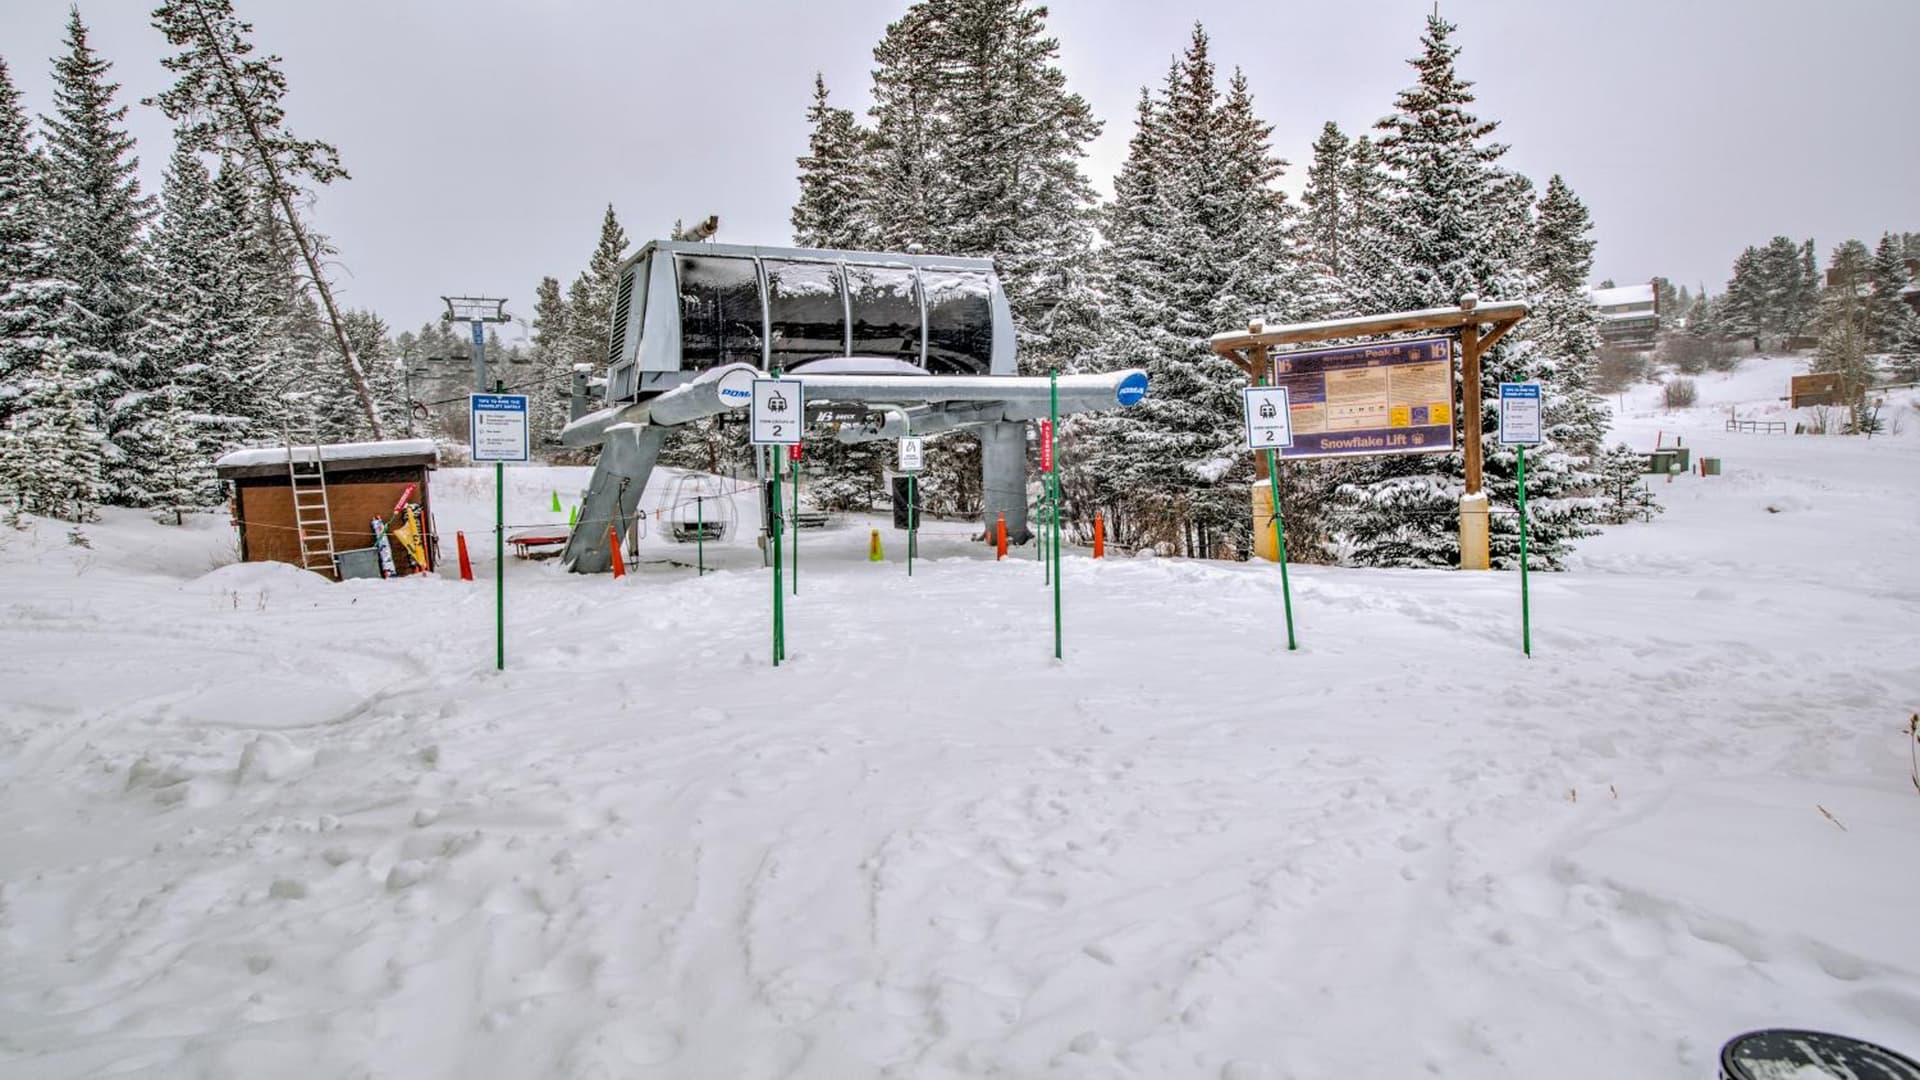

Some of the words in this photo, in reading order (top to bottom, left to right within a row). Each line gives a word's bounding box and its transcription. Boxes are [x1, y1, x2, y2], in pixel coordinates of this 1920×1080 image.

[1365, 348, 1391, 358] Peak
[772, 424, 782, 437] 2
[1266, 430, 1275, 441] 2
[1320, 436, 1383, 450] Snowflake
[1386, 433, 1408, 446] Lift
